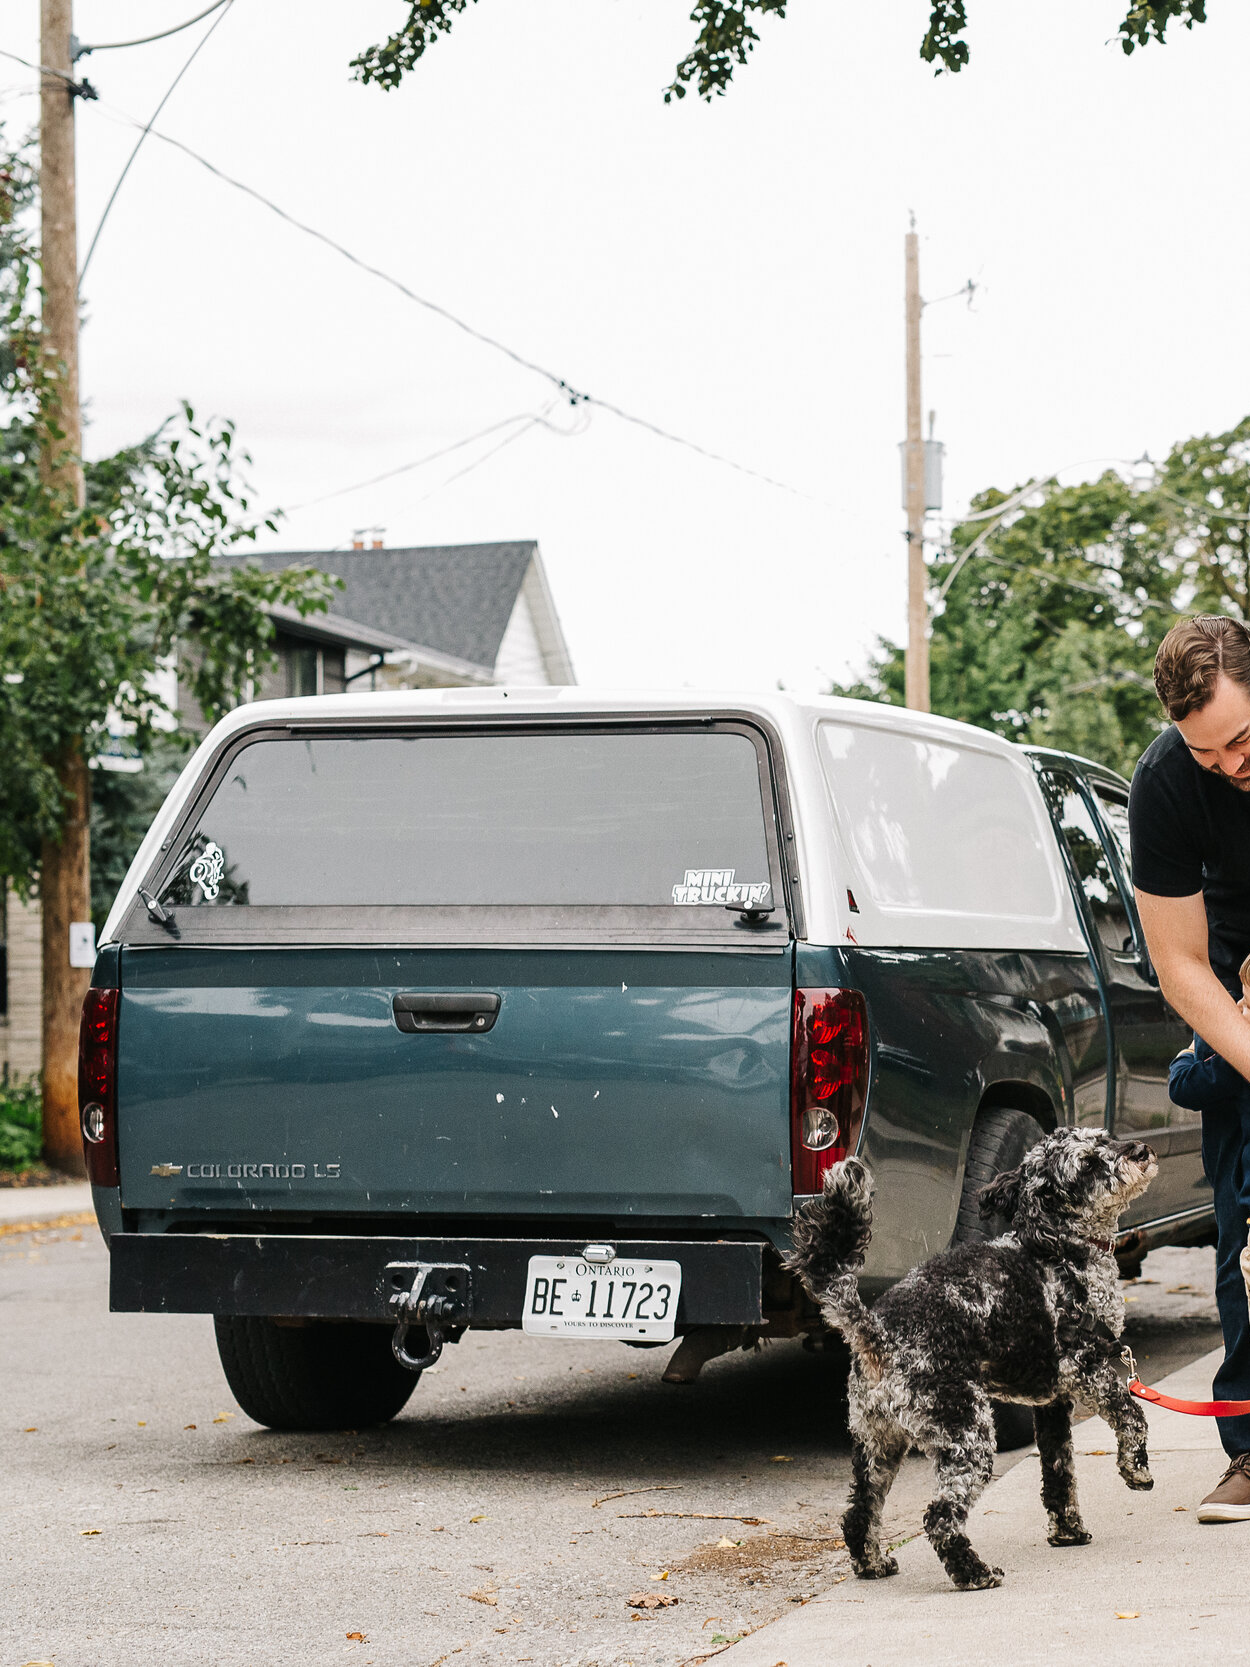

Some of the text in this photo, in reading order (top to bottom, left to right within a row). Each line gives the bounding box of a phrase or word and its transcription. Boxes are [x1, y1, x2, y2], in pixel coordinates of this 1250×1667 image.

[686, 871, 732, 887] MINI
[674, 885, 768, 902] TRUCKIN'
[186, 1163, 341, 1178] COLORADO LS
[531, 1277, 672, 1320] BE 11723
[599, 1321, 635, 1329] DISCOVER
